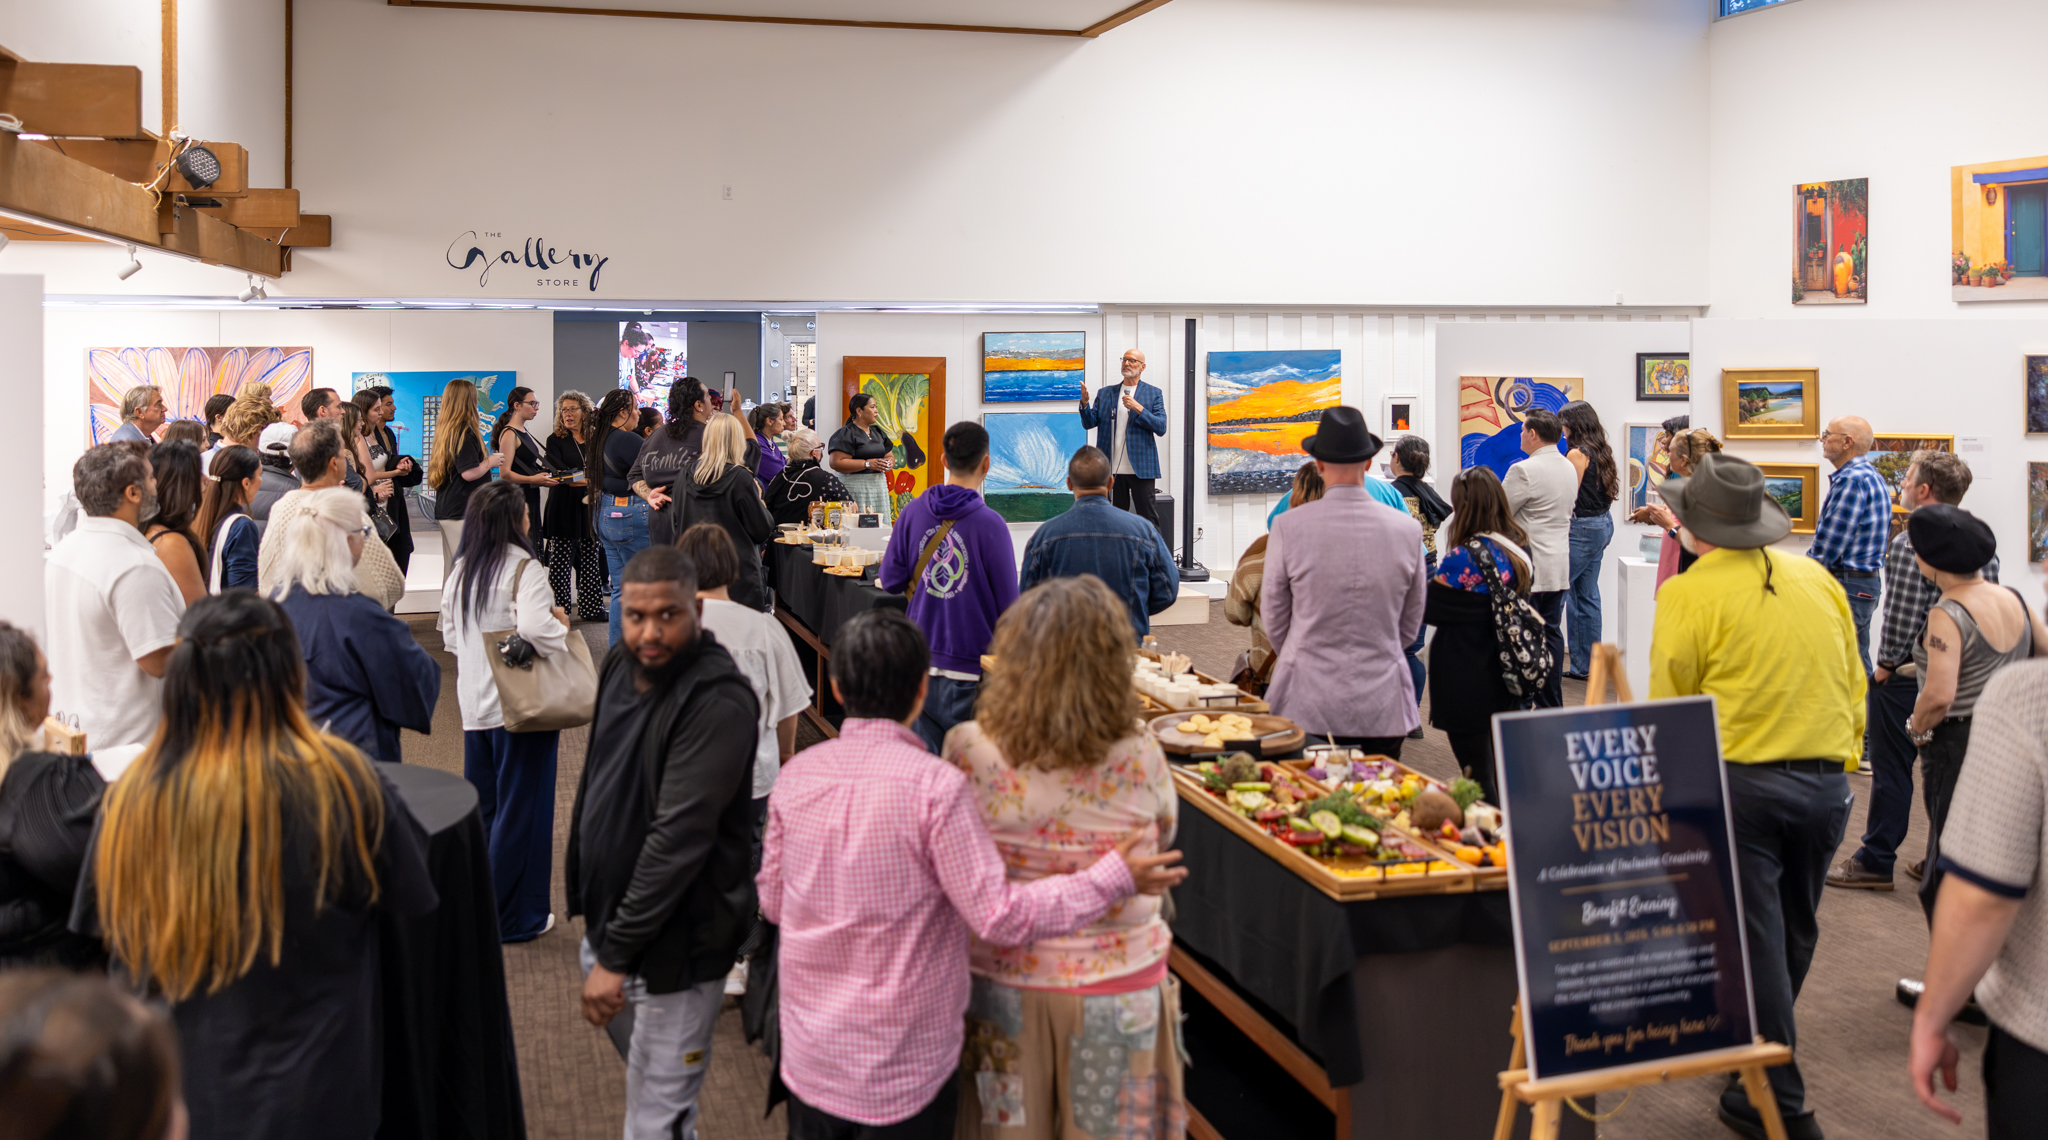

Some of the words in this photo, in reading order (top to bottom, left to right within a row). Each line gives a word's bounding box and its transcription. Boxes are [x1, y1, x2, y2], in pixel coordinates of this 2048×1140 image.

[446, 230, 609, 291] Gallery
[536, 279, 579, 287] STORE
[641, 446, 698, 475] Famili
[1564, 724, 1657, 761] EVERY
[1569, 754, 1661, 790] VOICE
[1571, 783, 1664, 822] EVERY
[1571, 813, 1670, 852] VISION
[1537, 868, 1548, 882] A
[1549, 861, 1604, 880] Celebration
[1605, 857, 1618, 875] of
[1618, 853, 1659, 871] Inclusive
[1661, 848, 1711, 866] Creativity
[1581, 897, 1627, 926] Benefit
[1628, 894, 1679, 920] Evening
[1549, 932, 1612, 954] SEPTEMBER
[1699, 918, 1716, 932] PM
[1564, 1031, 1600, 1057] Thank
[1602, 1033, 1625, 1055] you
[1625, 1026, 1645, 1053] for
[1646, 1022, 1679, 1046] being
[1680, 1016, 1706, 1034] here
